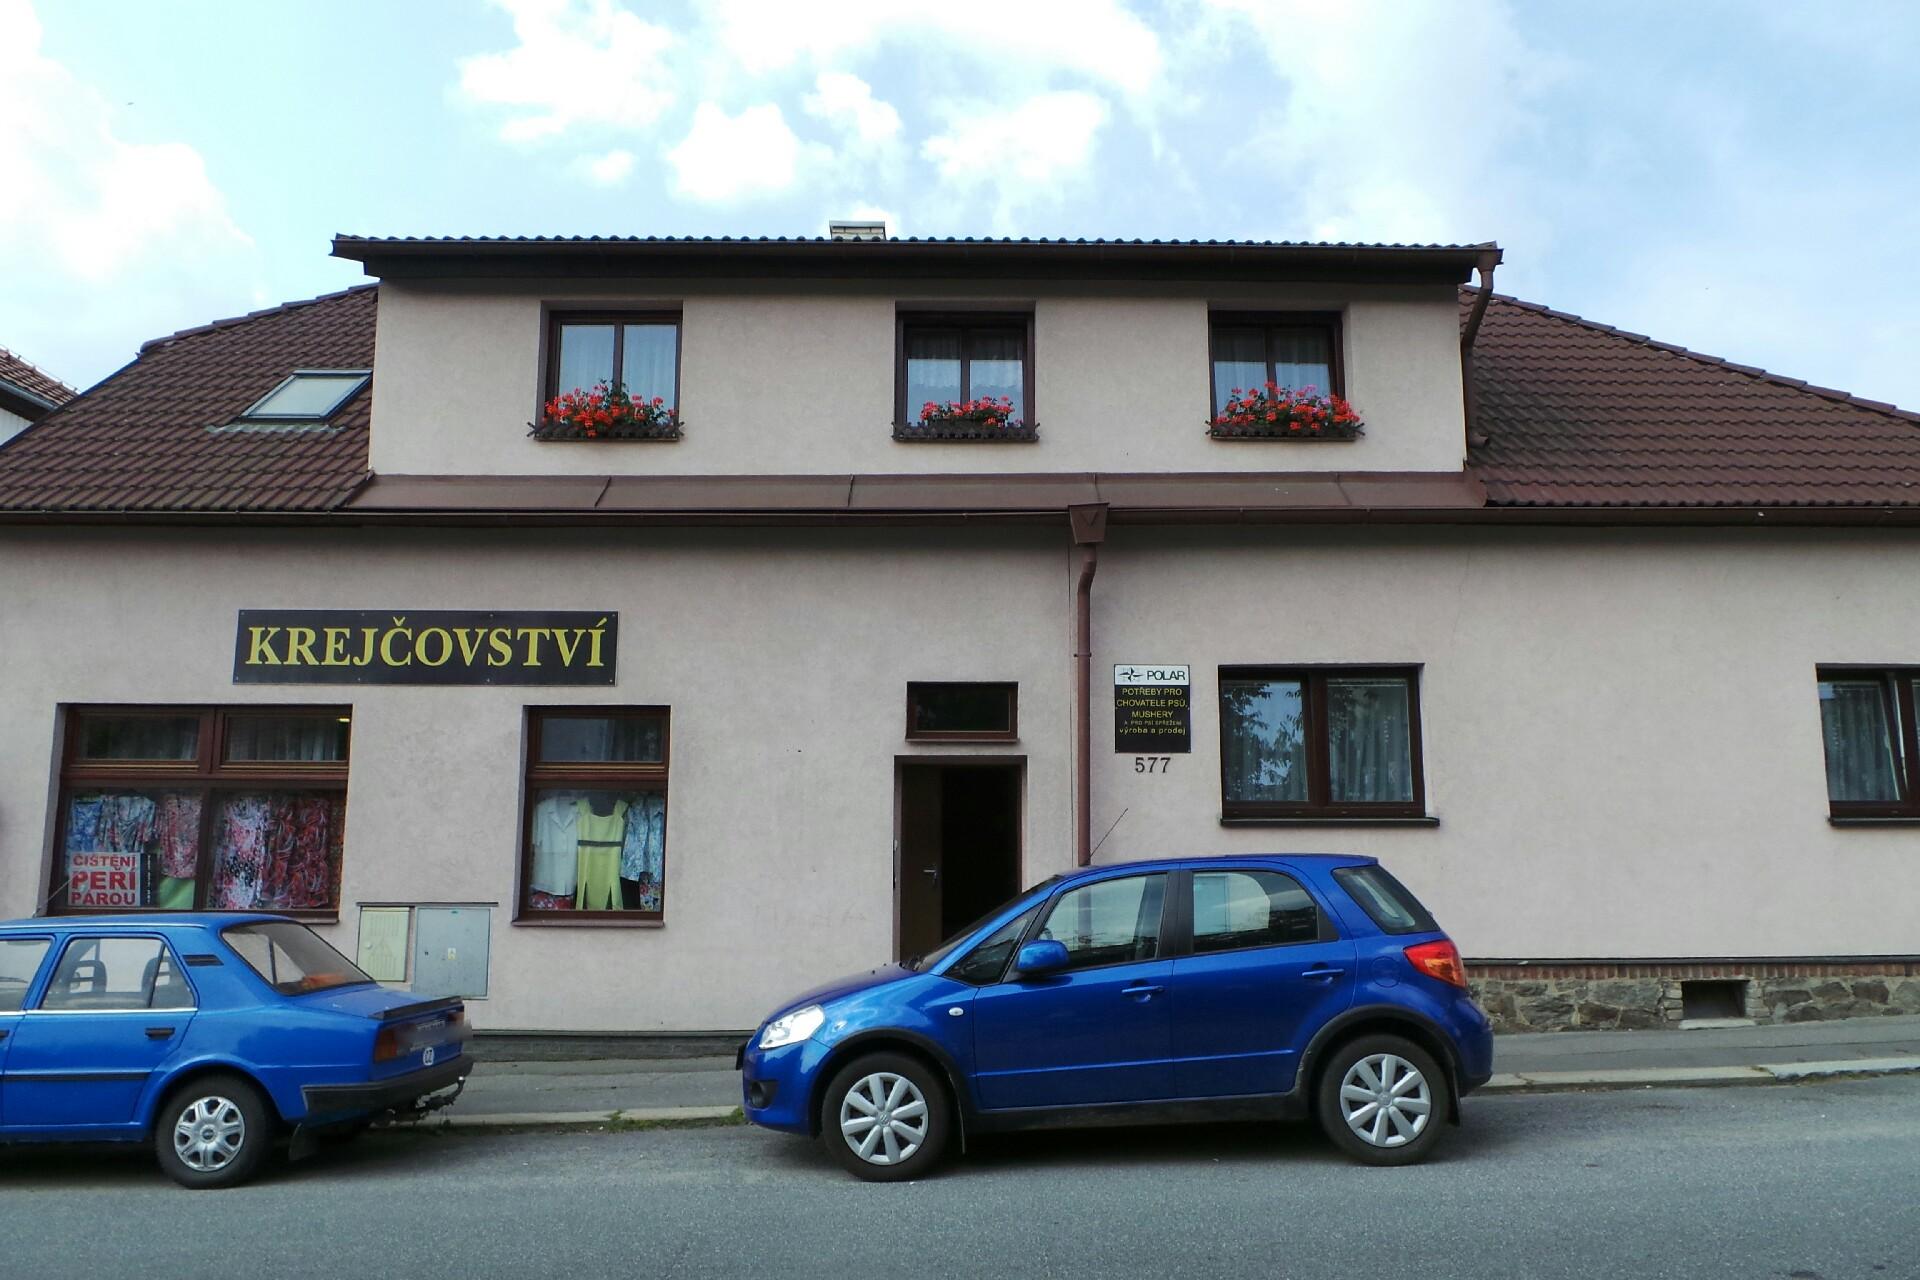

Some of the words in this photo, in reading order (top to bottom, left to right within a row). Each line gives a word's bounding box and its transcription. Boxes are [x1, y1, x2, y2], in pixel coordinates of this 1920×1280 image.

[245, 616, 607, 667] KREJČOVSTVÍ
[1147, 671, 1185, 681] POLAR
[1122, 687, 1161, 696] POTŘEBY
[1164, 688, 1182, 696] PRO
[1131, 710, 1173, 718] MUSHERY
[1120, 726, 1148, 735] výroba
[1159, 727, 1186, 735] prodej
[1135, 756, 1171, 773] 577
[71, 867, 136, 890] PEŘÍ
[71, 892, 136, 905] PAROU
